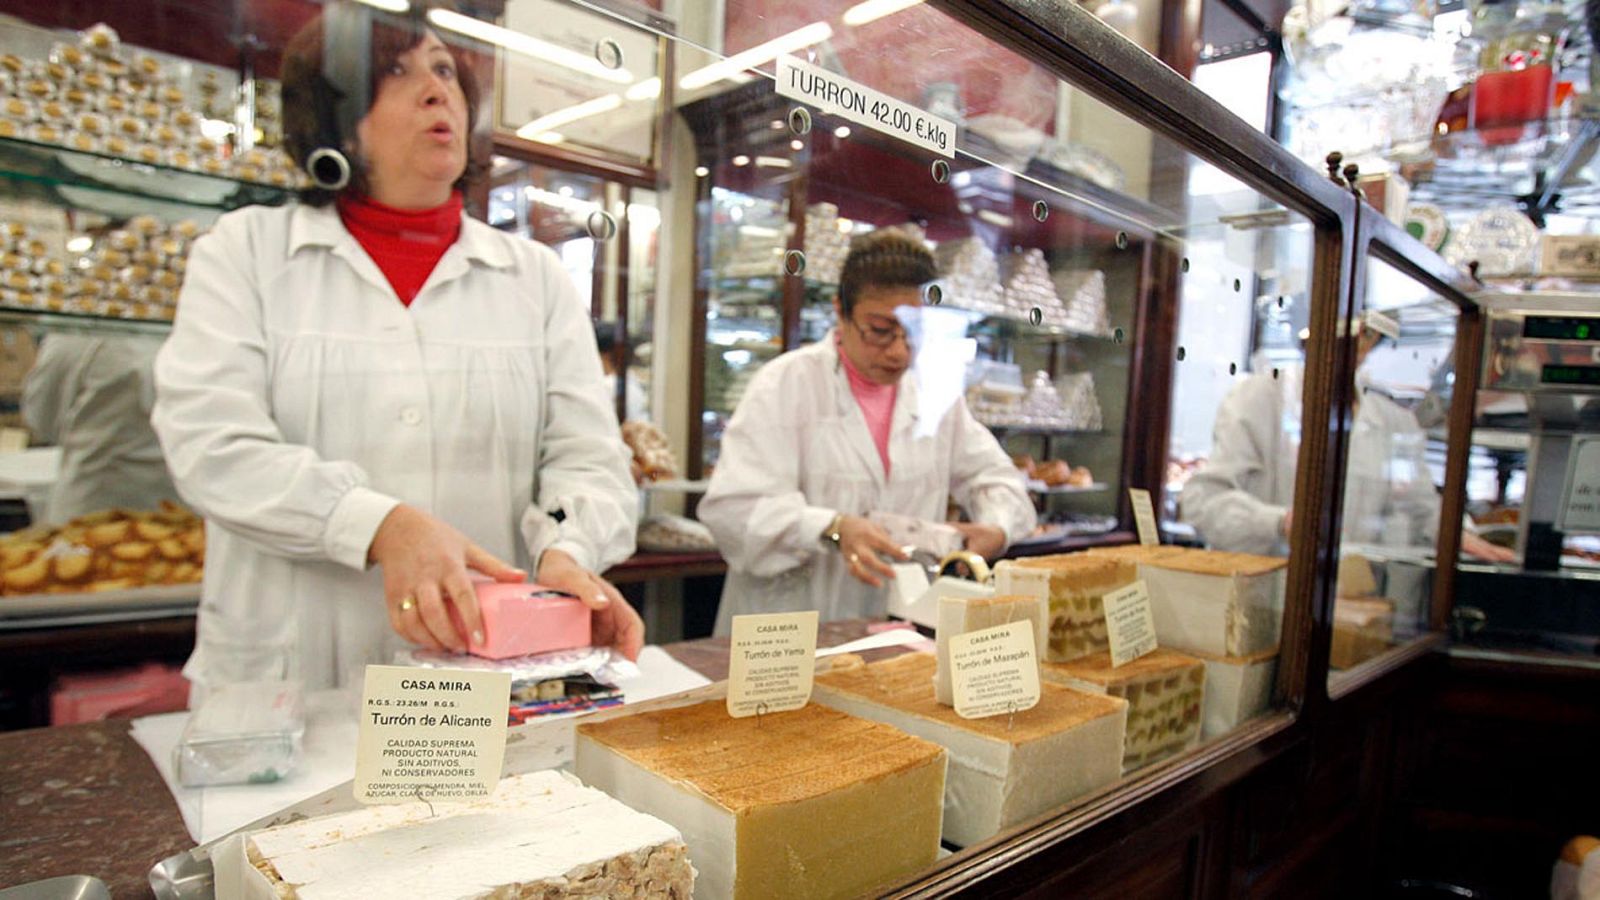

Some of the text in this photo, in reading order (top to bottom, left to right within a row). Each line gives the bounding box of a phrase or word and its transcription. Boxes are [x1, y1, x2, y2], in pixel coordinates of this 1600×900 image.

[788, 65, 866, 115] TURRON
[870, 100, 911, 133] 42.00
[757, 625, 777, 633] CASA
[970, 631, 1010, 645] CASA MIRA
[744, 650, 770, 660] Turrón
[401, 680, 472, 691] CASA MIRA
[371, 712, 492, 727] Turrón de Alicante
[387, 739, 475, 748] CALIDAD SUPREMA
[382, 749, 434, 757] PRODUCTO
[397, 759, 414, 767] SIN
[381, 769, 475, 777] NI CONSERVADORES
